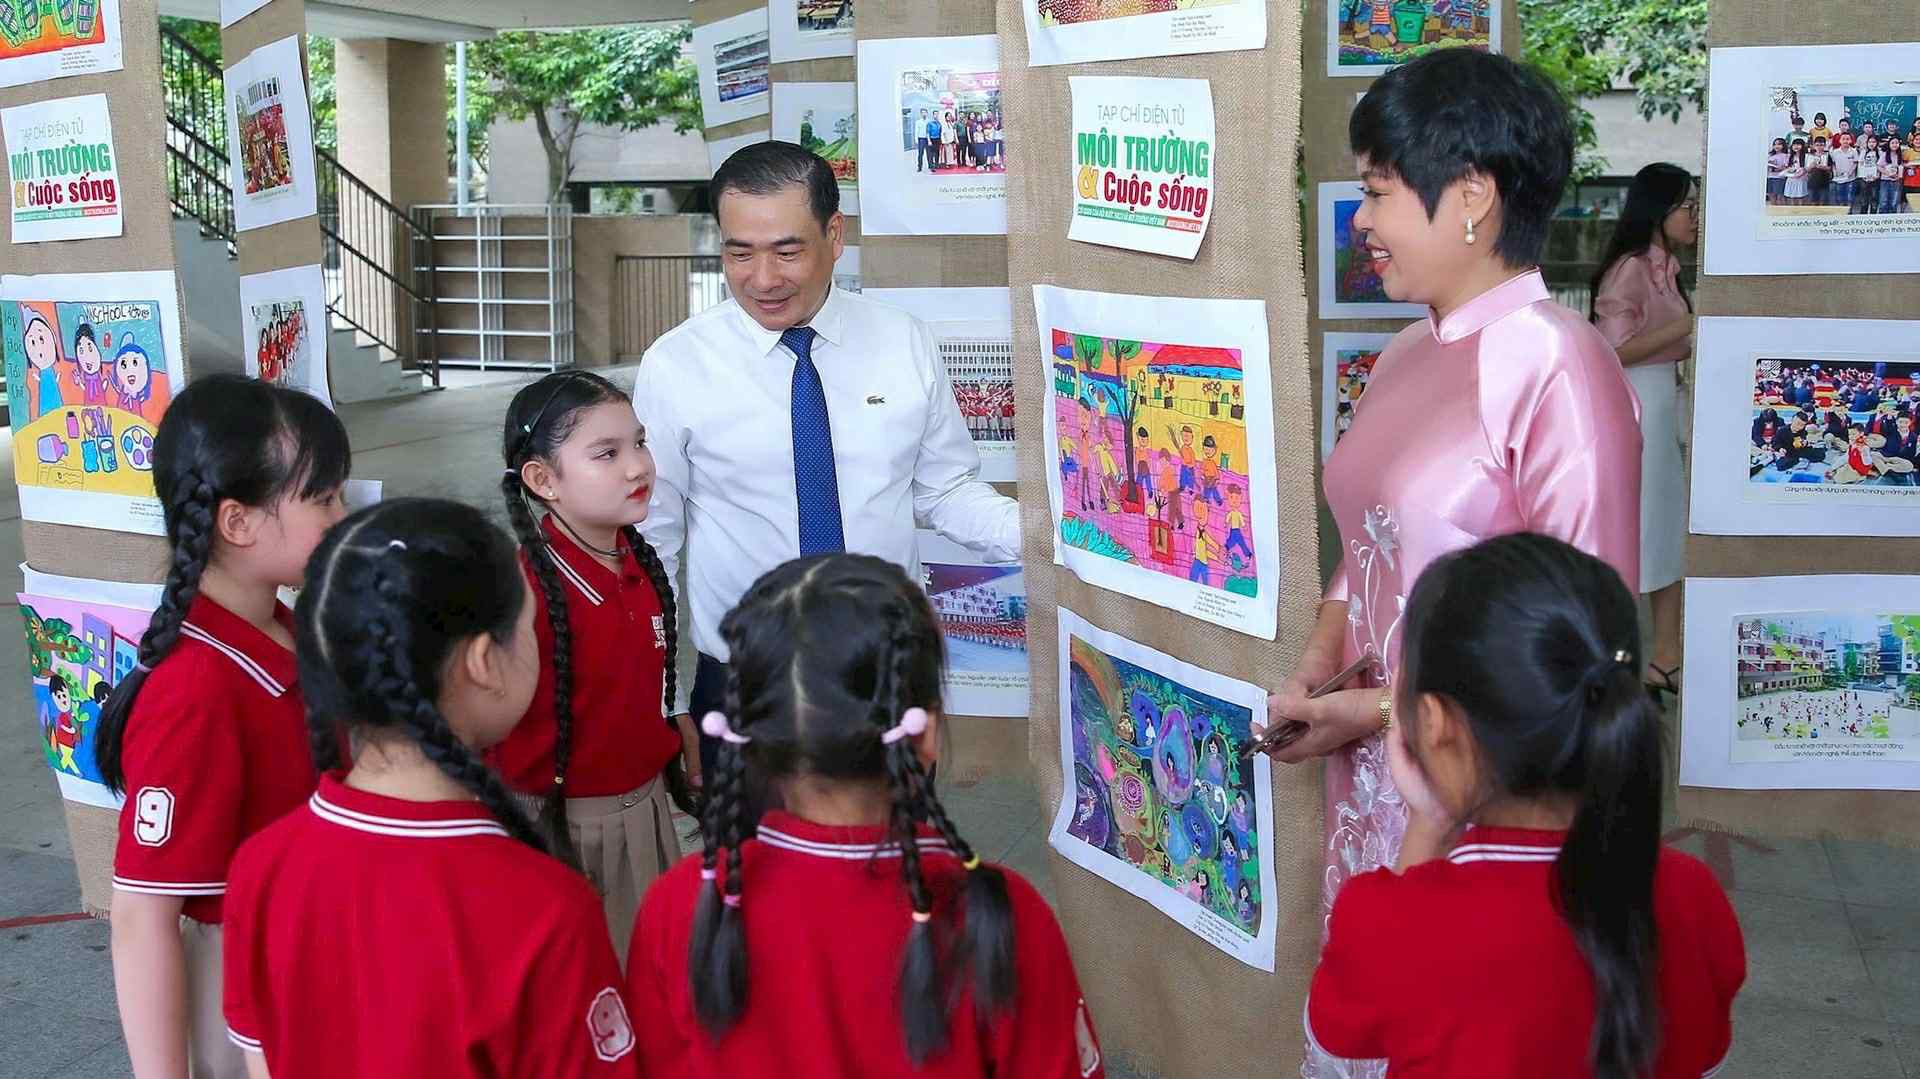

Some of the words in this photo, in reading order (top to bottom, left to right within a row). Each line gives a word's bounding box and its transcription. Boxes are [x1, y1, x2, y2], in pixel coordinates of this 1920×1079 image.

[1120, 103, 1140, 122] CHÍ
[1143, 104, 1169, 127] ĐIỆN
[11, 146, 34, 181] MÔI
[36, 138, 111, 178] TRƯỜNG
[1077, 126, 1118, 169] MÔI
[1123, 129, 1209, 178] TRƯỜNG
[28, 179, 63, 210] Cuộc
[68, 172, 116, 203] sống
[1103, 171, 1152, 212] Cuộc
[1157, 174, 1208, 218] sống
[134, 786, 175, 847] 9
[586, 986, 636, 1062] 9
